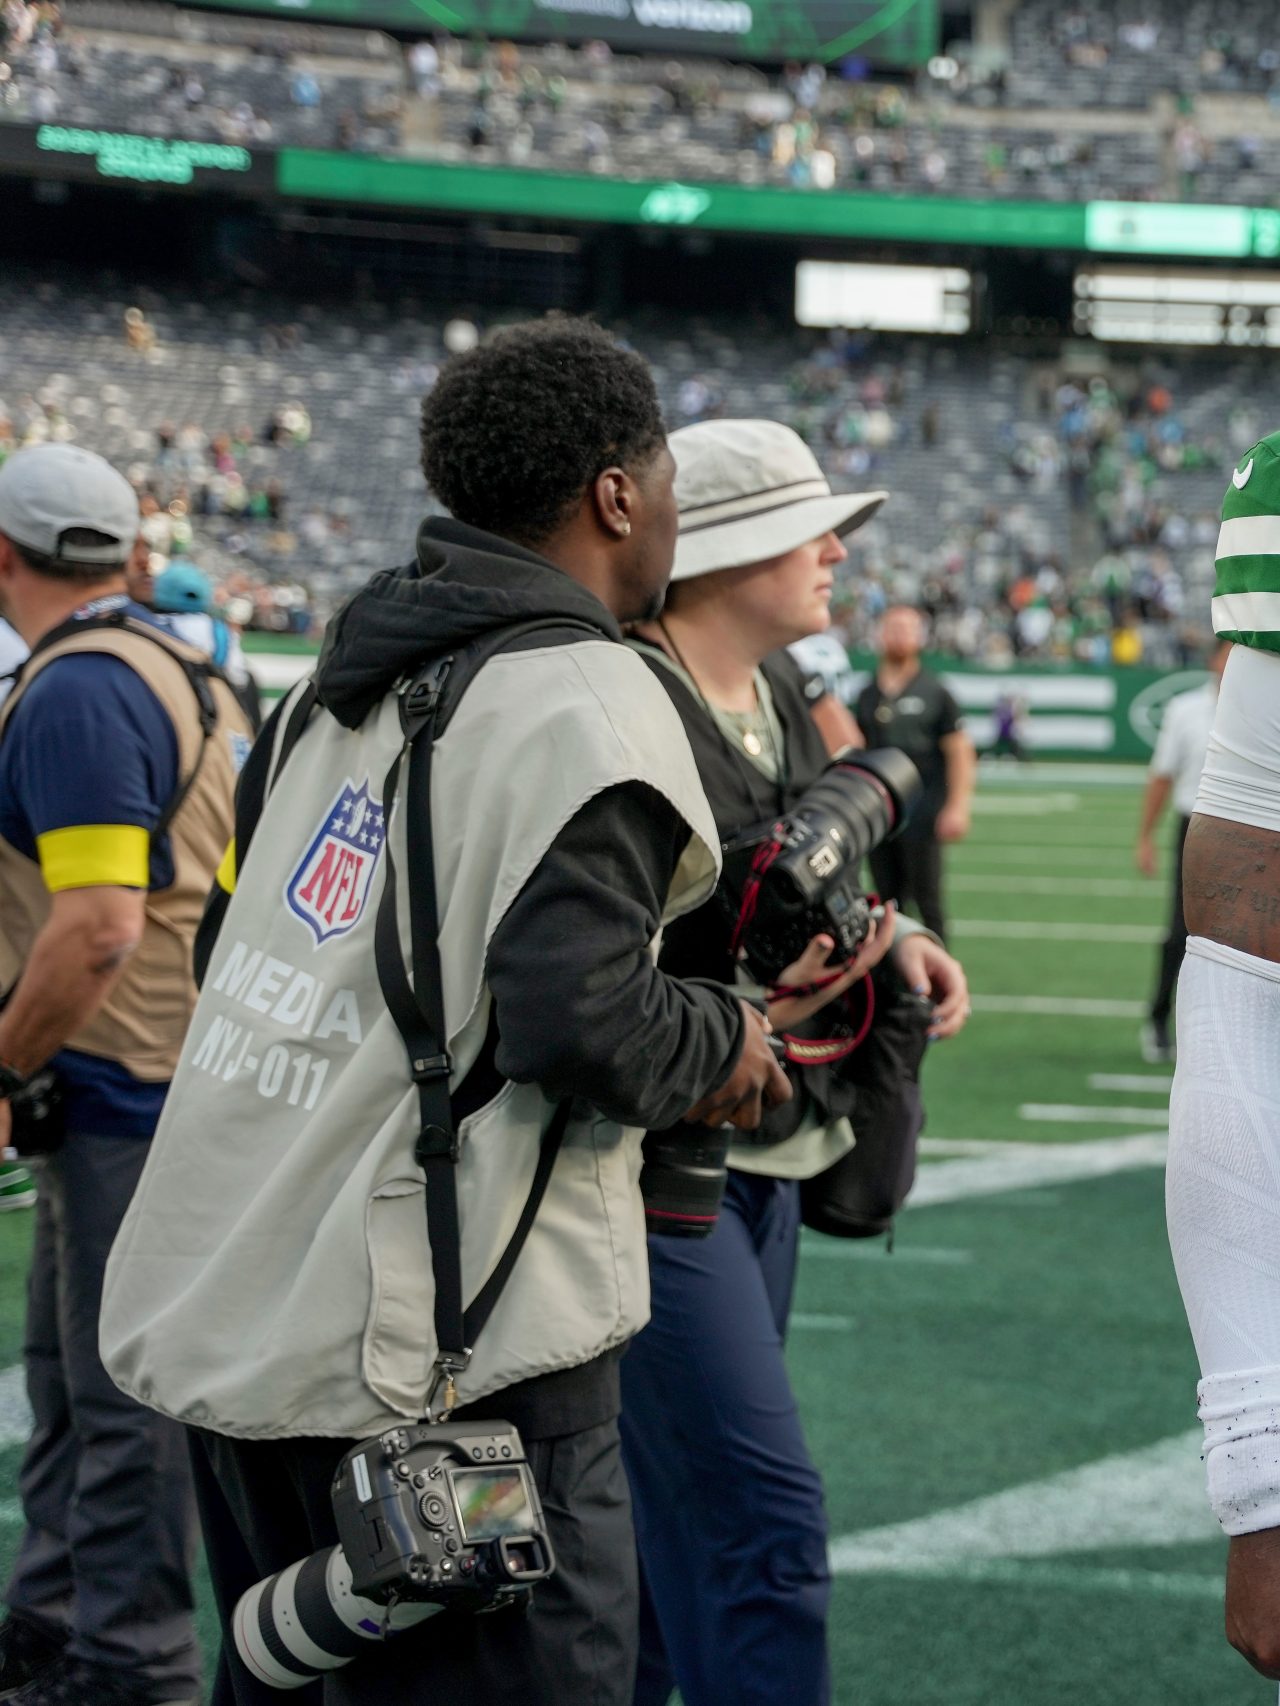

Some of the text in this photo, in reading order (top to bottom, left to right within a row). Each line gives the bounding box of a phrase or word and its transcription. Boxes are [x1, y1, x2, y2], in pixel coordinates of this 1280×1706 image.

[299, 842, 364, 925] NFL
[212, 941, 363, 1044] MEDIA
[191, 1014, 330, 1111] NYJ-011
